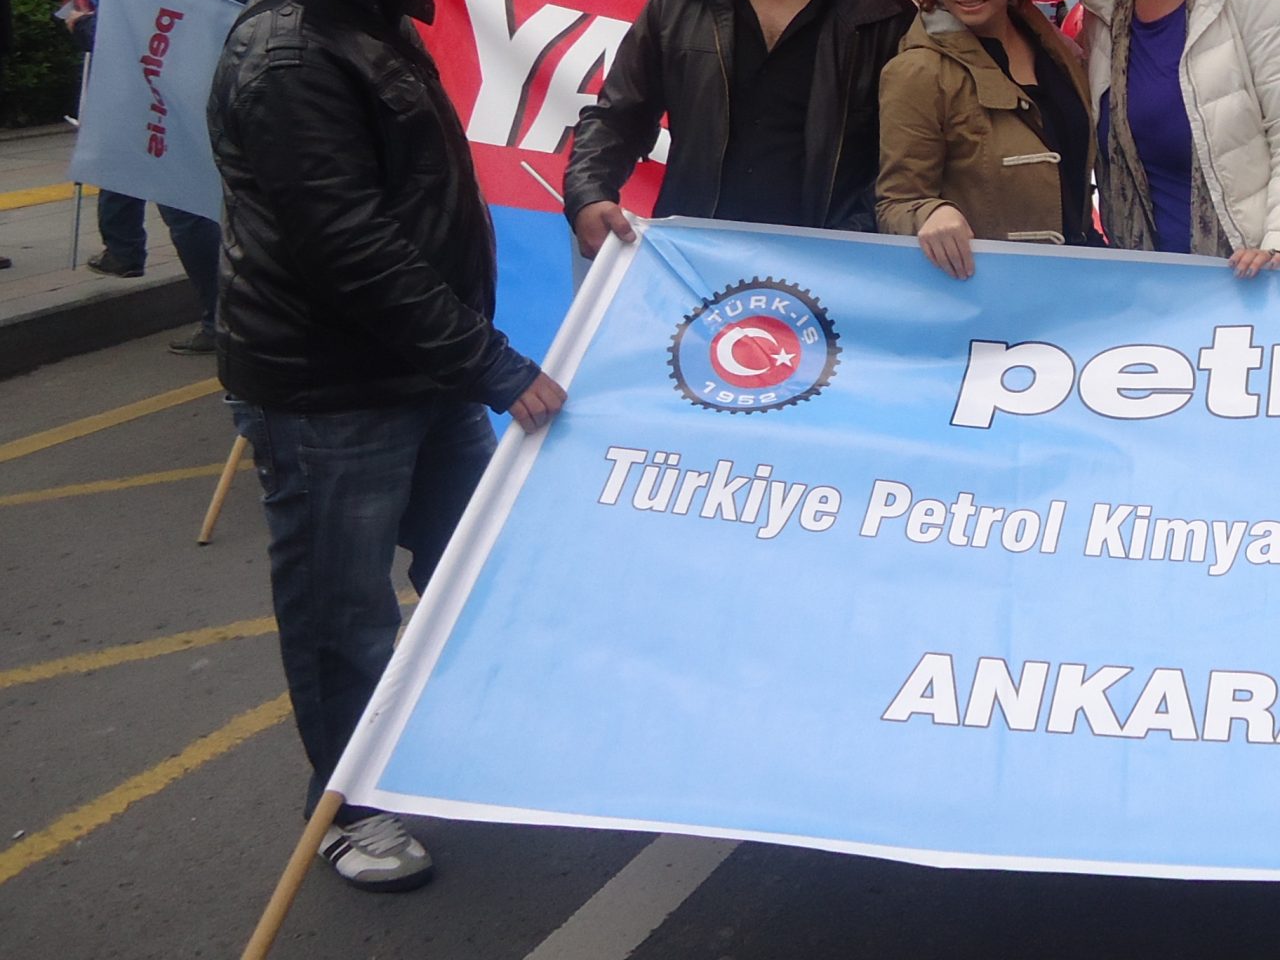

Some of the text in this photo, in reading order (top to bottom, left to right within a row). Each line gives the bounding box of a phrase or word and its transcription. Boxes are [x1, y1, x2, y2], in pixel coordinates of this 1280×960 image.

[706, 295, 820, 346] TÜRK-İŞ
[702, 380, 778, 406] 1952
[597, 445, 842, 539] Türkiye
[858, 478, 1067, 555] Petrol
